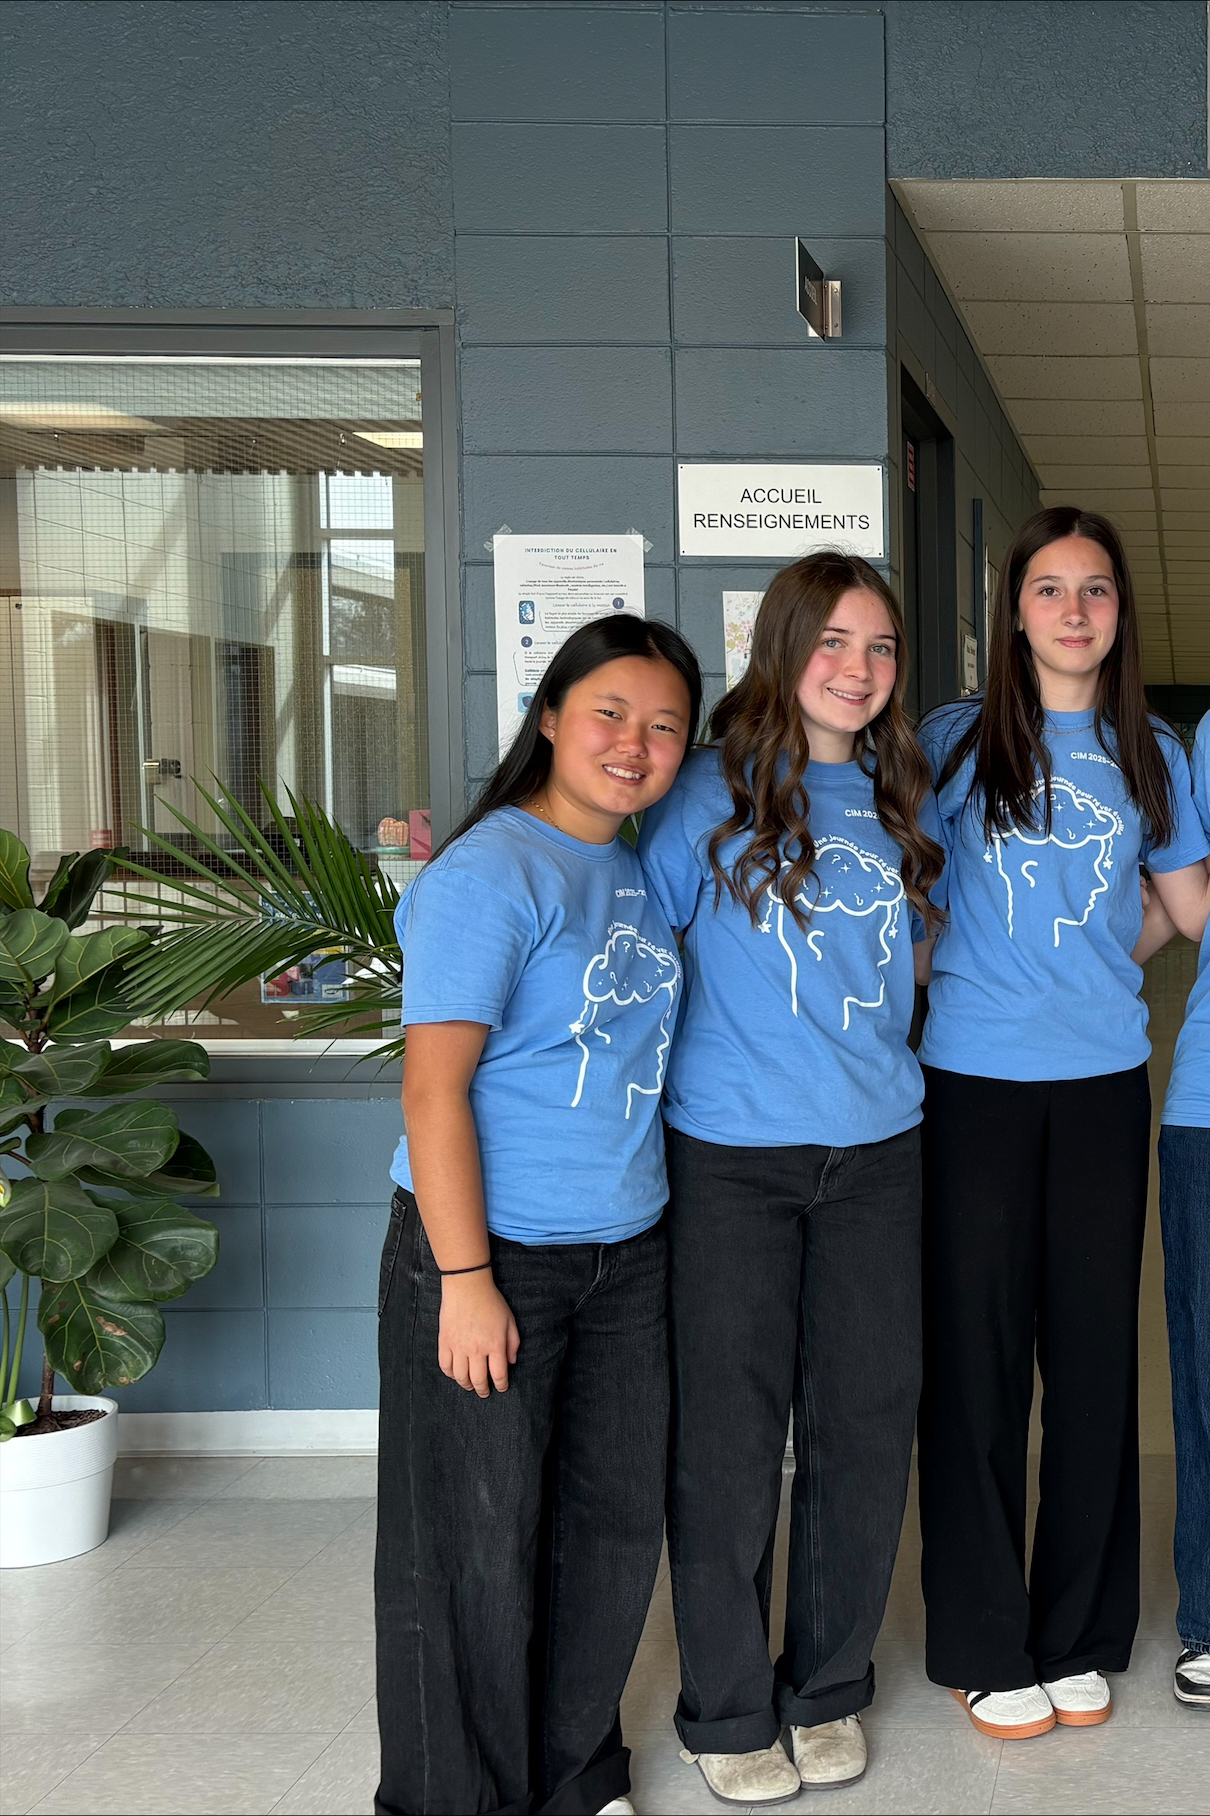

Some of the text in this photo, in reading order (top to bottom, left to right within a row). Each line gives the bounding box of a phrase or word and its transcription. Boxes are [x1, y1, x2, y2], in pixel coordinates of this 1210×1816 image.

[740, 488, 822, 504] ACCUEIL
[694, 513, 870, 530] RENSEIGNEMENTS
[1070, 752, 1087, 760] CIM
[1076, 788, 1094, 800] pour
[844, 809, 862, 817] CIM
[813, 836, 828, 848] Une
[859, 849, 879, 860] pour
